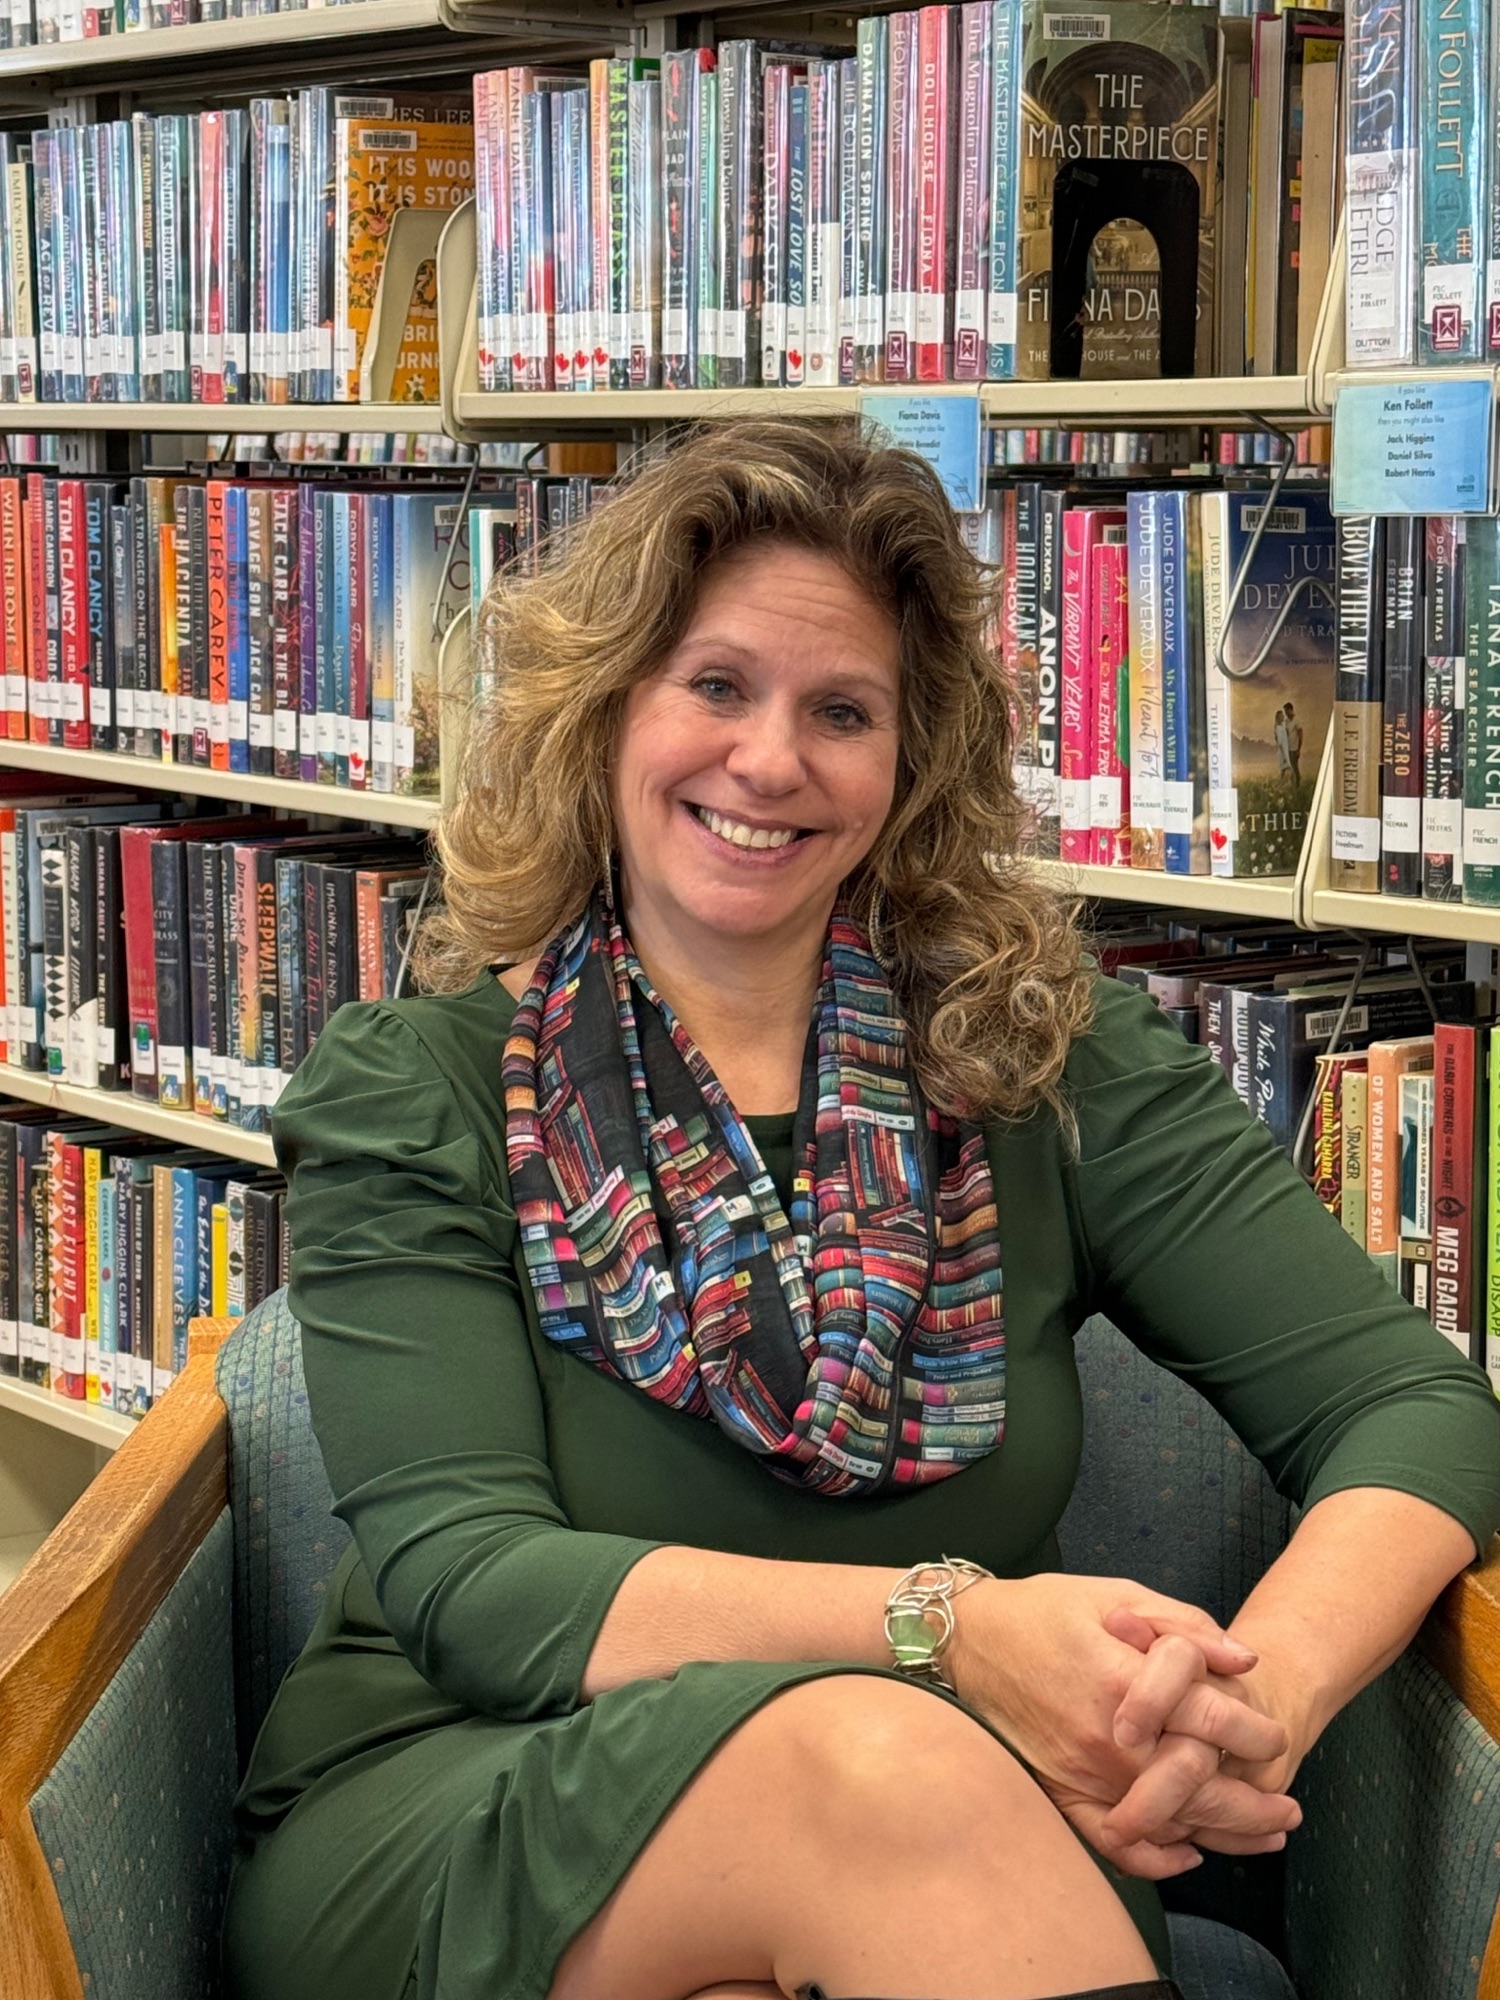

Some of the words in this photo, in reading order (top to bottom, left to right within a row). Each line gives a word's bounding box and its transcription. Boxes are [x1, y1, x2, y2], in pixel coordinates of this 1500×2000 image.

[968, 17, 980, 43] The
[995, 14, 1010, 51] THE
[893, 30, 905, 96] FIONA
[721, 66, 735, 159] Fellowship
[861, 43, 873, 160] DAMNATION
[965, 60, 980, 150] Magnolia
[1094, 73, 1144, 109] THE
[610, 67, 628, 178] MASTER
[892, 101, 904, 153] DAVIS
[923, 63, 935, 184] DOLLHOUSE
[995, 59, 1009, 190] MASTERPIECE
[1027, 123, 1209, 161] MASTERPIECE
[1434, 30, 1467, 178] FOLLETT
[1455, 224, 1473, 261] THE
[368, 156, 389, 176] IT
[397, 156, 417, 177] IS
[424, 157, 474, 178] WOO
[723, 164, 734, 209] Point
[965, 157, 978, 218] Palace
[11, 170, 23, 224] EMILY'S
[368, 184, 389, 204] IT
[397, 184, 417, 204] IS
[424, 184, 474, 205] STON
[790, 167, 803, 215] LOST
[859, 171, 872, 242] SPRING
[610, 192, 627, 278] CLASS
[790, 222, 803, 270] LOVE
[923, 215, 933, 273] FIONA
[1375, 190, 1397, 262] EDGE
[14, 228, 26, 277] HOUSE
[993, 241, 1006, 292] FION
[1027, 287, 1114, 323] FINA
[1360, 299, 1387, 308] FOLLETT
[1432, 291, 1463, 300] FOLLETT
[991, 342, 1003, 368] VIS
[1355, 337, 1391, 347] DUTTON
[898, 410, 919, 421] Fiona
[920, 409, 941, 420] Davis
[1383, 400, 1402, 412] Ken
[1404, 399, 1434, 411] Follett
[1386, 434, 1404, 444] Jack
[1405, 433, 1435, 445] Higgins
[1387, 450, 1412, 461] Daniel
[1413, 450, 1433, 460] Silva
[1384, 468, 1410, 477] Robert
[1411, 468, 1436, 477] Harris
[2, 491, 14, 552] WHEN
[45, 500, 54, 532] MARC
[59, 496, 72, 542] TOM
[86, 498, 101, 545] TOM
[135, 503, 144, 511] A
[176, 507, 186, 532] THE
[273, 499, 286, 543] JACK
[1018, 500, 1029, 531] THE
[135, 516, 146, 586] STRANGER
[209, 497, 223, 579] PETER
[249, 506, 260, 574] SAVAGE
[1138, 504, 1154, 558] JUDE
[1162, 512, 1173, 558] JUDE
[4, 561, 15, 579] IN
[31, 535, 41, 582] JUST
[45, 535, 55, 588] CAMERON
[274, 555, 287, 601] CARR
[1435, 535, 1444, 584] DONNA
[4, 585, 16, 644] ROME
[60, 549, 76, 636] CLANCY
[89, 551, 102, 638] CLANCY
[137, 590, 146, 609] ON
[174, 539, 191, 647] HACIENDA
[249, 581, 261, 617] SON
[1016, 542, 1036, 652] HOOLIGANS
[1163, 563, 1175, 652] DEVERAUX
[1340, 584, 1368, 630] THE
[1398, 567, 1413, 621] BRIAN
[1434, 587, 1444, 642] FREITAS
[32, 595, 42, 638] ONE
[138, 615, 146, 639] THE
[210, 589, 224, 688] CAREY
[275, 628, 287, 641] IN
[1063, 592, 1083, 670] VIBRANT
[1138, 563, 1155, 673] DEVERAUX
[46, 640, 57, 671] COLD
[67, 644, 76, 672] RED
[249, 635, 260, 676] JACK
[1038, 608, 1056, 715] ANON
[1338, 636, 1369, 677] LAW
[1467, 622, 1479, 658] THE
[137, 644, 147, 688] BEACH
[276, 653, 288, 680] THE
[1164, 668, 1175, 686] My
[250, 683, 261, 714] CAR
[1063, 675, 1083, 732] YEARS
[1099, 681, 1110, 701] THE
[1165, 690, 1177, 731] Heart
[1099, 702, 1111, 744] EMMA
[1210, 703, 1219, 745] THIEF
[1343, 712, 1359, 727] J.
[1467, 668, 1479, 768] SEARCHER
[1165, 737, 1177, 764] Will
[1210, 747, 1219, 764] OF
[1394, 730, 1411, 777] ZERO
[1485, 685, 1500, 810] FRENCH
[1343, 747, 1360, 813] FREEDM
[203, 857, 213, 883] THE
[204, 888, 215, 931] RIVER
[279, 867, 290, 934] BLACK
[206, 937, 216, 952] OF
[257, 882, 276, 997] SLEEPWALK
[367, 919, 376, 971] TRACY
[206, 955, 217, 1003] SILVER
[281, 942, 292, 1019] RABBIT
[262, 1011, 275, 1039] DAN
[1207, 1000, 1222, 1034] THEN
[263, 1043, 276, 1068] CHA
[282, 1028, 294, 1068] HAL
[1256, 1020, 1276, 1071] While
[1372, 1075, 1383, 1095] OF
[1443, 1057, 1455, 1085] DARK
[1254, 1076, 1274, 1123] Pari
[1320, 1091, 1334, 1133] KATALINA
[1443, 1087, 1456, 1135] CORNERS
[1371, 1098, 1383, 1163] WOMEN
[1420, 1103, 1428, 1143] HUNDRED
[1320, 1136, 1335, 1179] GAMARRA
[1442, 1159, 1455, 1190] NIGHT
[62, 1179, 75, 1226] LAST
[118, 1182, 128, 1221] MARY
[173, 1181, 183, 1229] ANN
[1371, 1168, 1383, 1201] AND
[1420, 1177, 1427, 1187] OF
[35, 1195, 43, 1222] LAST
[1371, 1206, 1382, 1244] SALT
[1419, 1189, 1427, 1230] SOLITUDE
[35, 1227, 43, 1289] CAROLINA
[63, 1235, 77, 1303] FLIGHT
[118, 1224, 128, 1279] HIGGINS
[1435, 1225, 1459, 1273] MEG
[173, 1236, 184, 1326] CLEEVES
[35, 1293, 44, 1320] GIRL
[118, 1283, 128, 1327] CLARK
[1435, 1278, 1457, 1333] GARD
